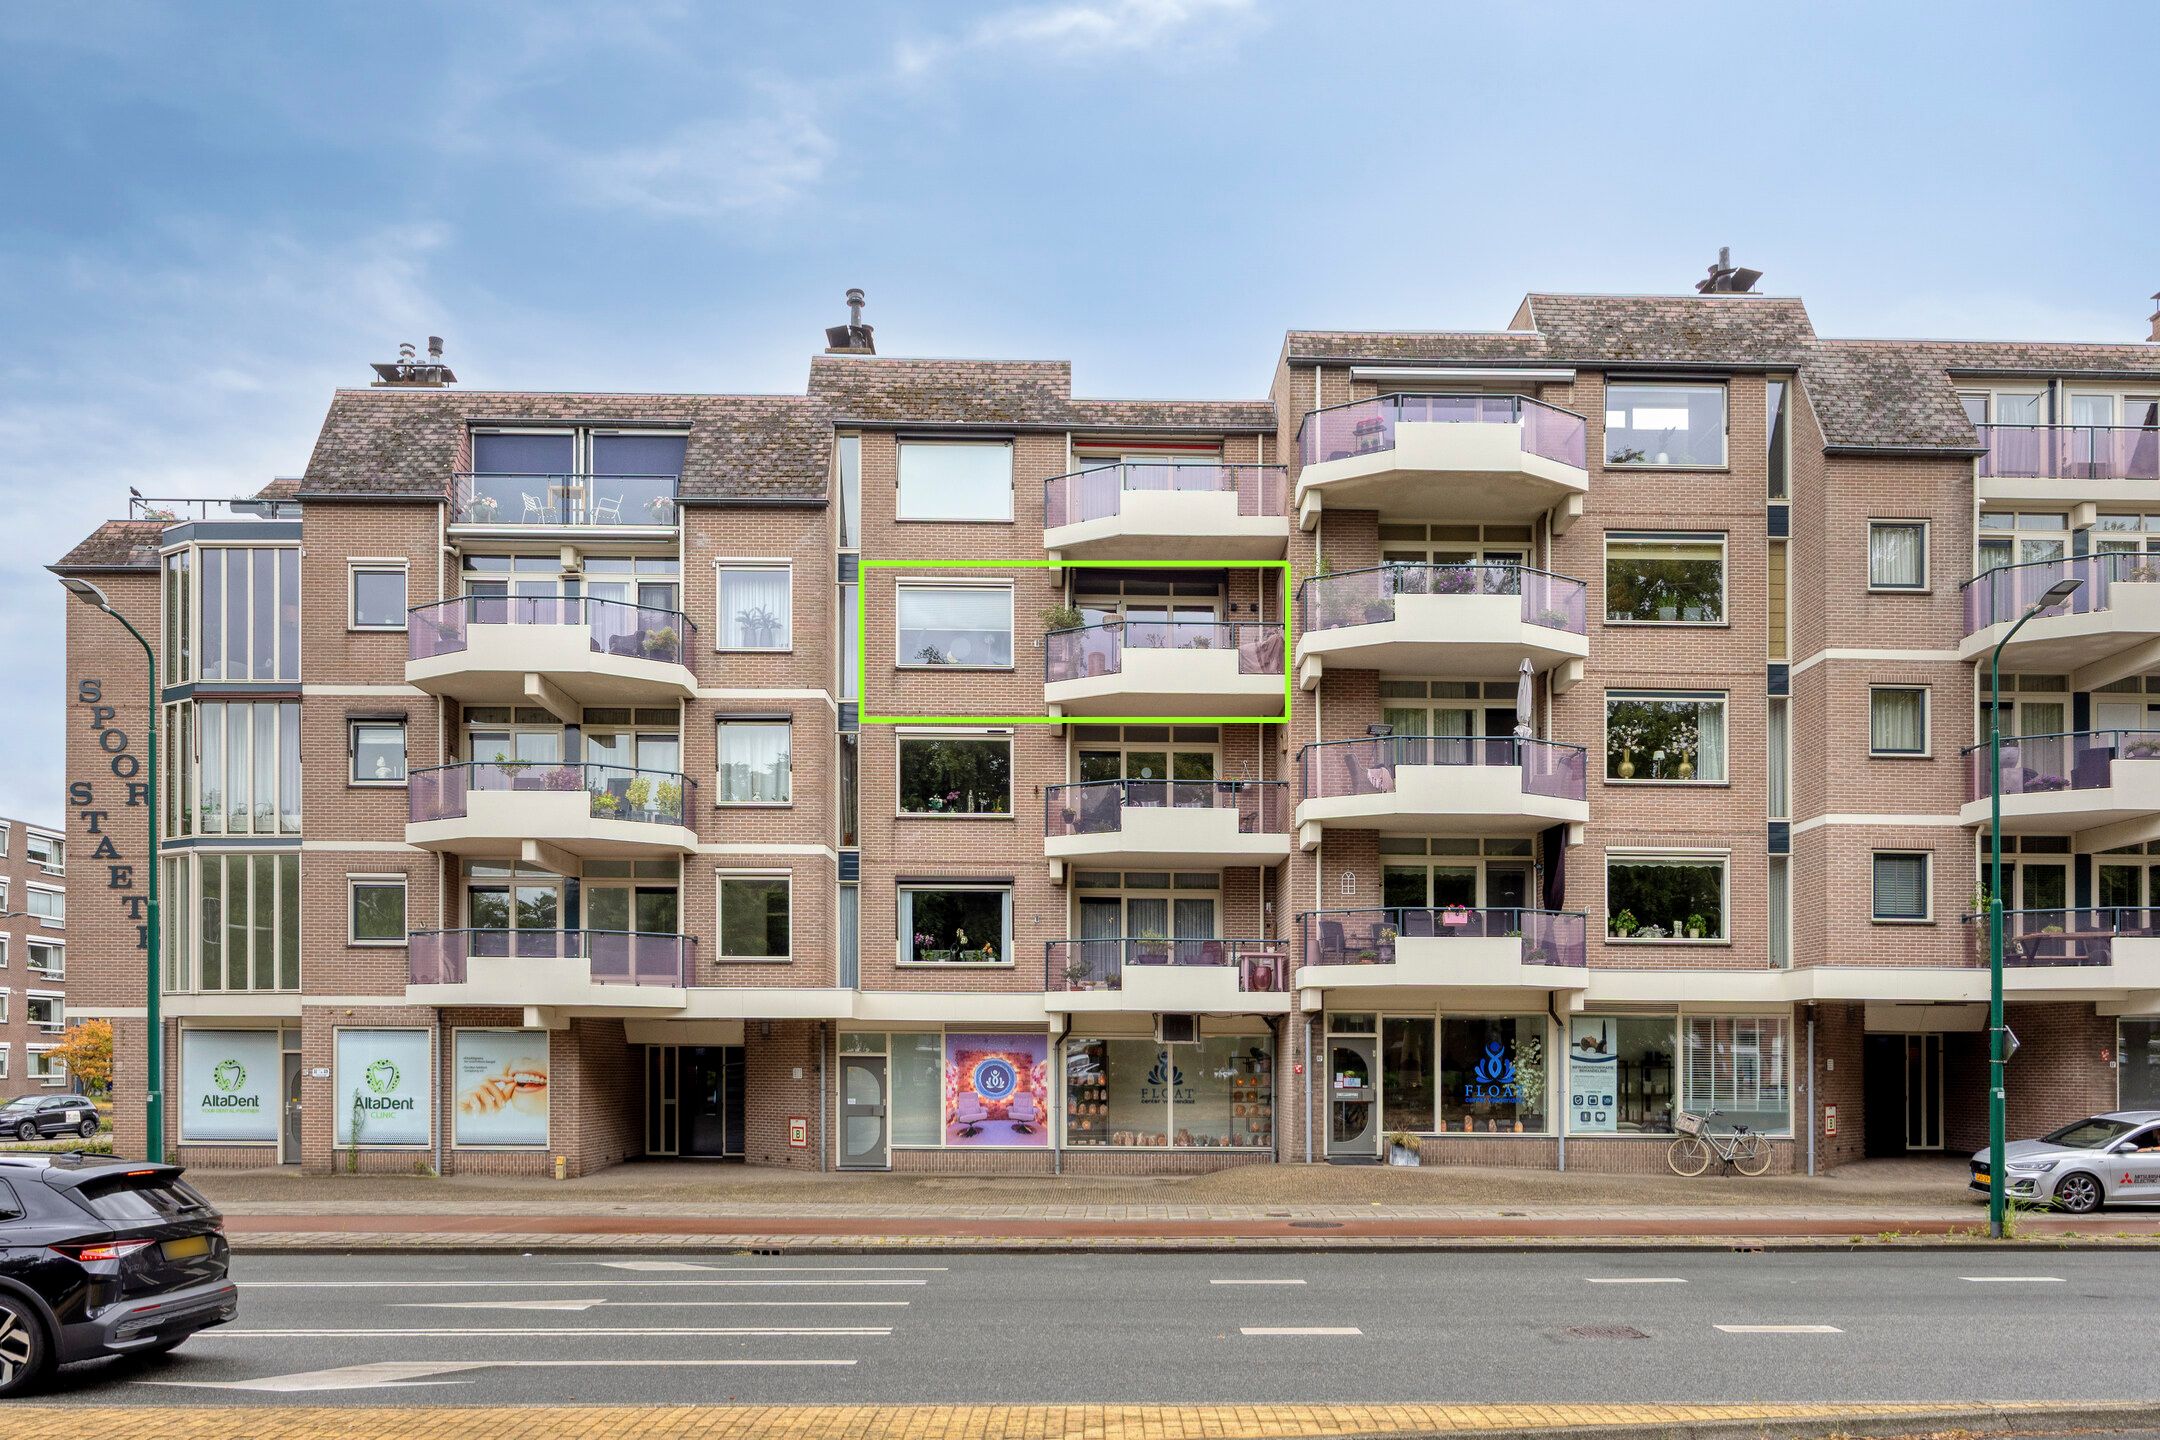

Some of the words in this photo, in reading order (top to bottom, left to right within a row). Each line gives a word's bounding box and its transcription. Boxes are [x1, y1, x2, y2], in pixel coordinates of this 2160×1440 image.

[78, 679, 149, 806] SPOOR
[1465, 1085, 1524, 1097] FLOAT
[201, 1094, 260, 1107] AltaDent
[353, 1097, 414, 1110] AltaDent
[370, 1111, 396, 1119] CLINIC
